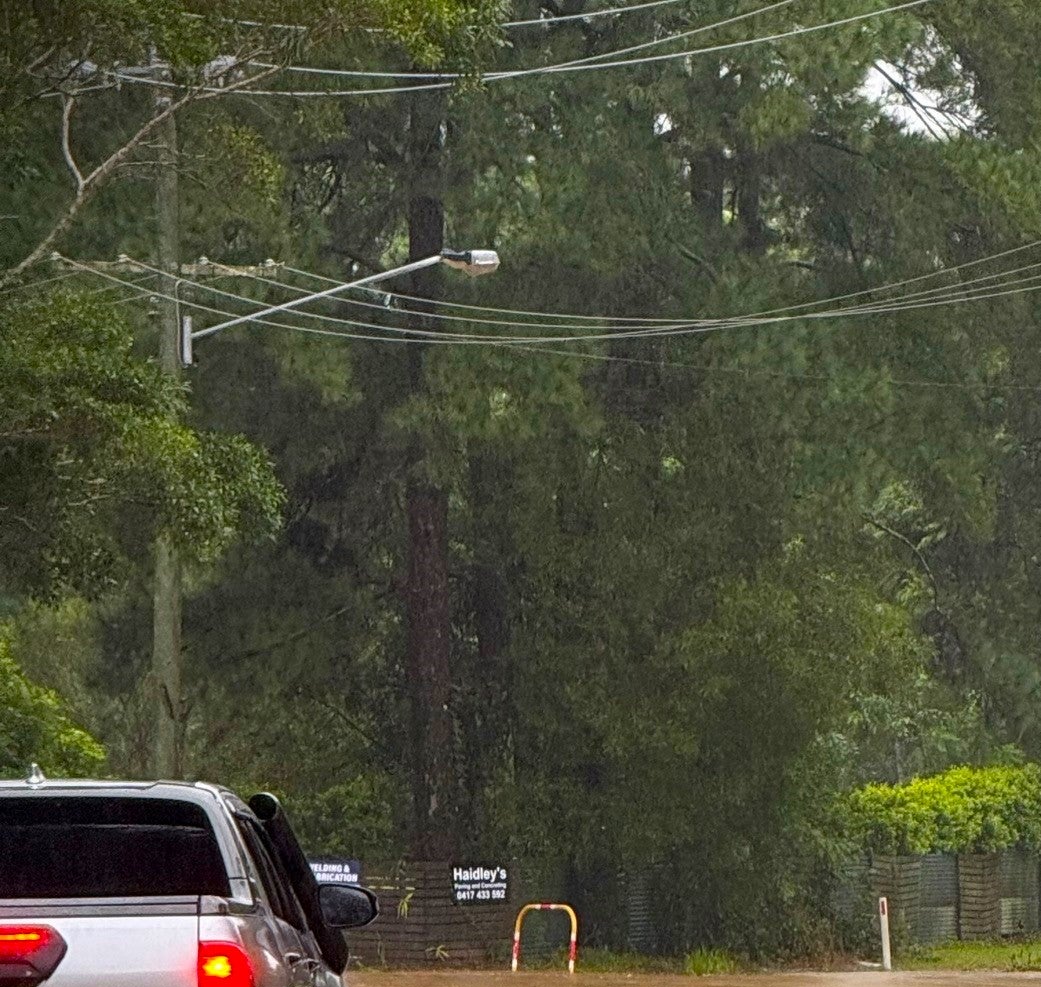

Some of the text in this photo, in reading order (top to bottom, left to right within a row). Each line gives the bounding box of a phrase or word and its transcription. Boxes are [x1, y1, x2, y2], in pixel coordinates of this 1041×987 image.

[344, 864, 350, 873] &
[314, 872, 358, 883] BRICATION
[453, 866, 507, 883] Haidley's
[456, 890, 475, 900] 0417
[476, 890, 490, 900] 433
